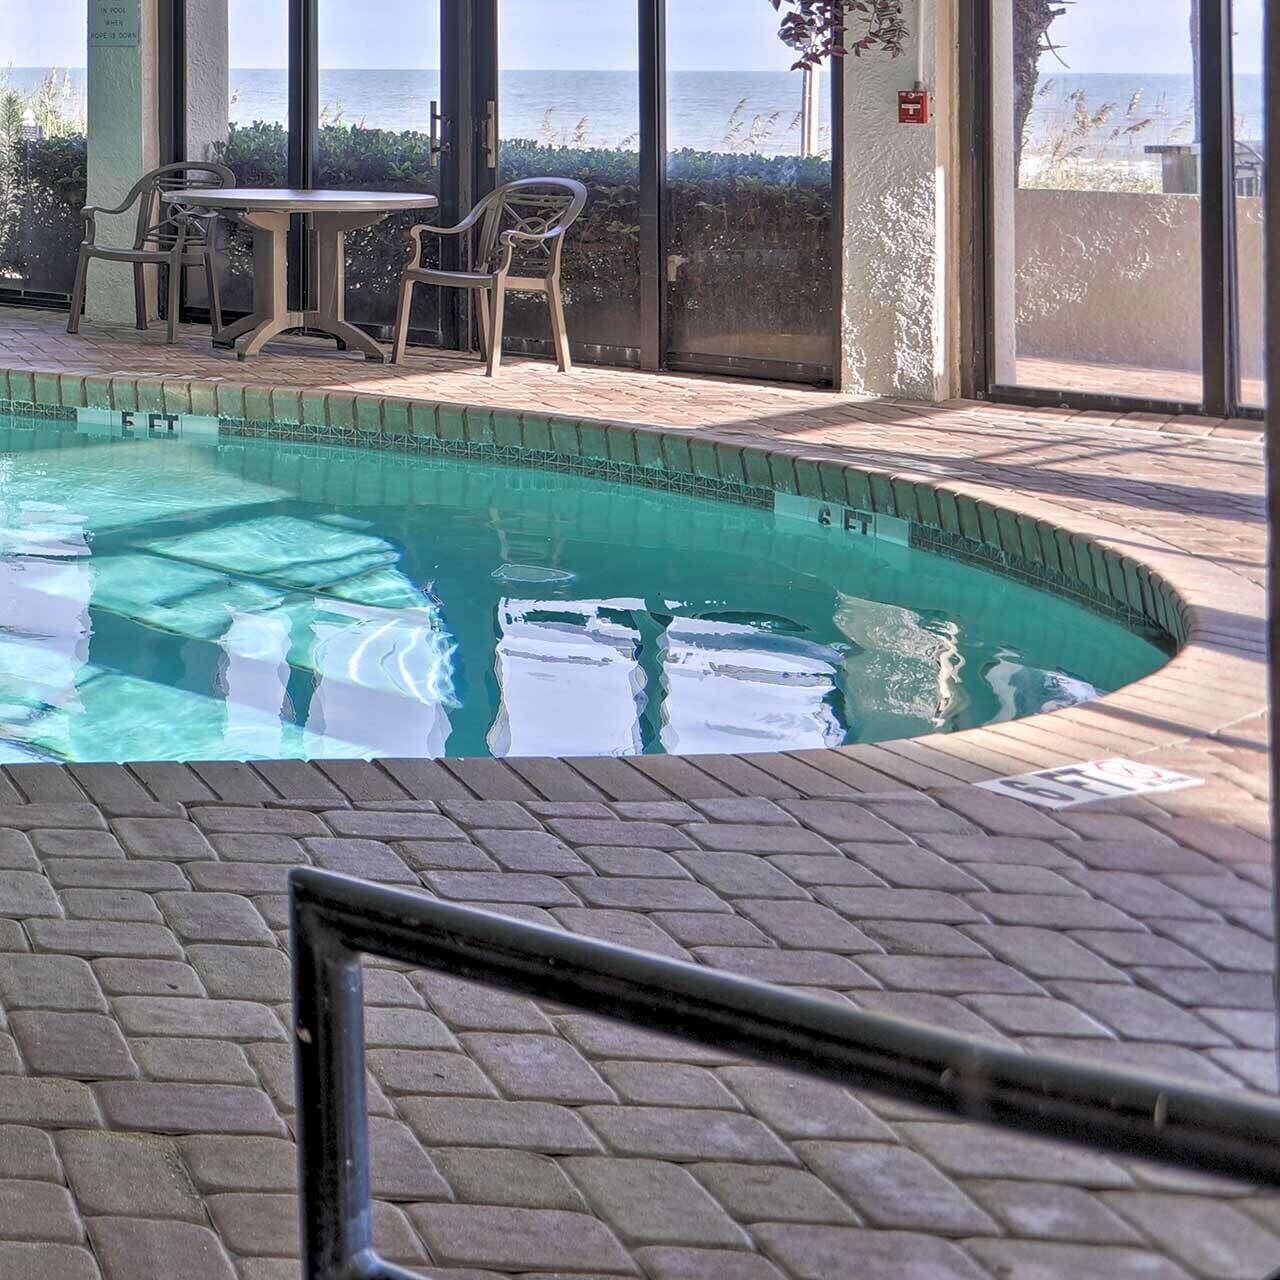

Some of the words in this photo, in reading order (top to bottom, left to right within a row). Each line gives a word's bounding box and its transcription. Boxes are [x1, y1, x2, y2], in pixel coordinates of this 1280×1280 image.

[121, 411, 135, 427] 5
[148, 413, 179, 431] FT
[844, 509, 873, 536] FT
[999, 779, 1075, 801] 6
[1033, 767, 1137, 797] FT
